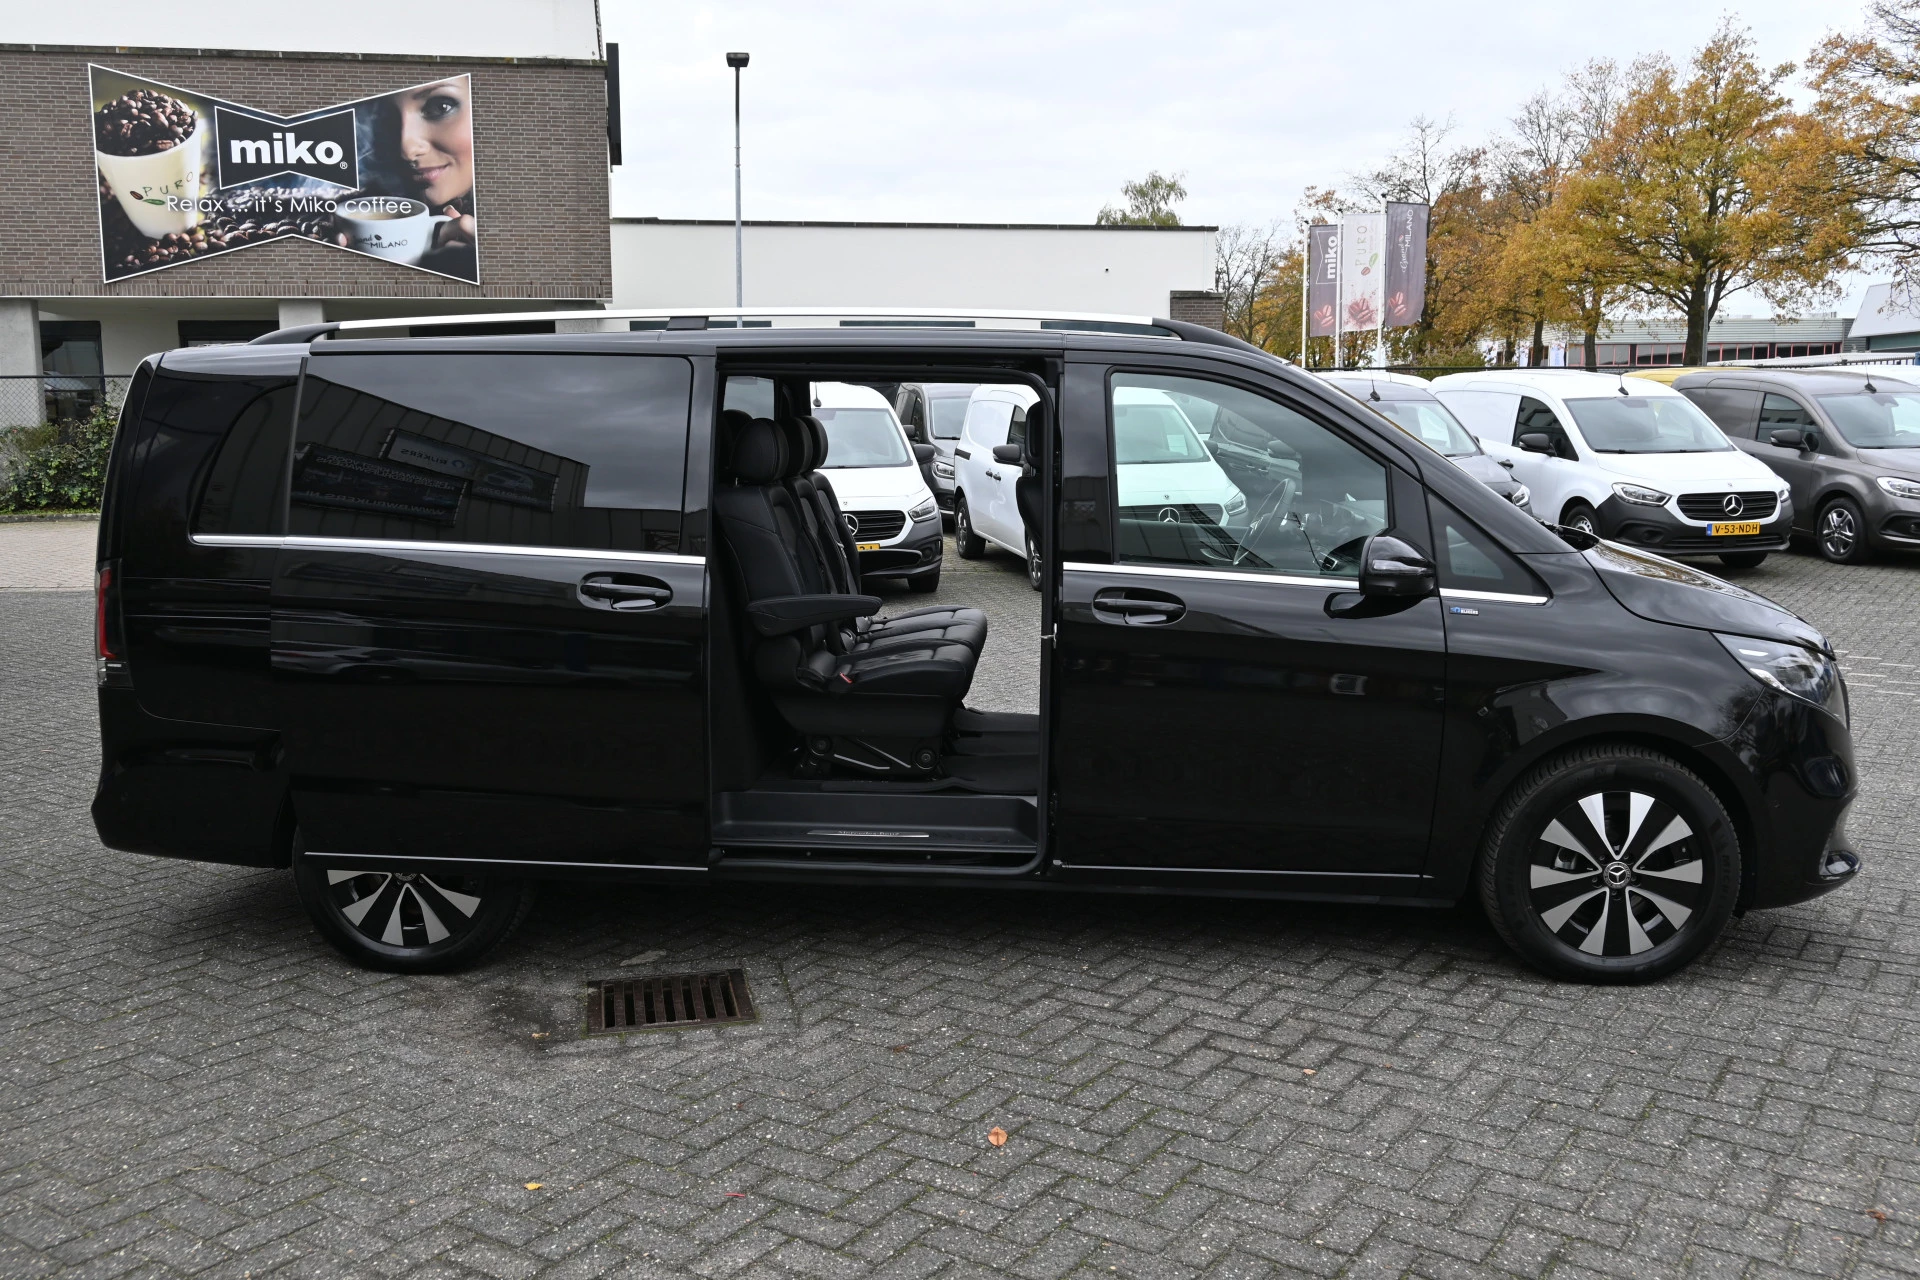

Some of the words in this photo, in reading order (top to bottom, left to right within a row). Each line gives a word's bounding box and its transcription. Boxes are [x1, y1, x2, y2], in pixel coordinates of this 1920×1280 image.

[142, 171, 194, 196] PURO
[167, 196, 224, 212] Relax
[255, 196, 283, 213] it's
[290, 196, 338, 213] Miko
[344, 196, 412, 214] coffee
[1405, 209, 1414, 248] MILANO
[370, 239, 408, 249] MILANO
[1355, 225, 1367, 266] PURO
[1325, 236, 1338, 279] miko
[1715, 524, 1758, 534] V-53-NDH
